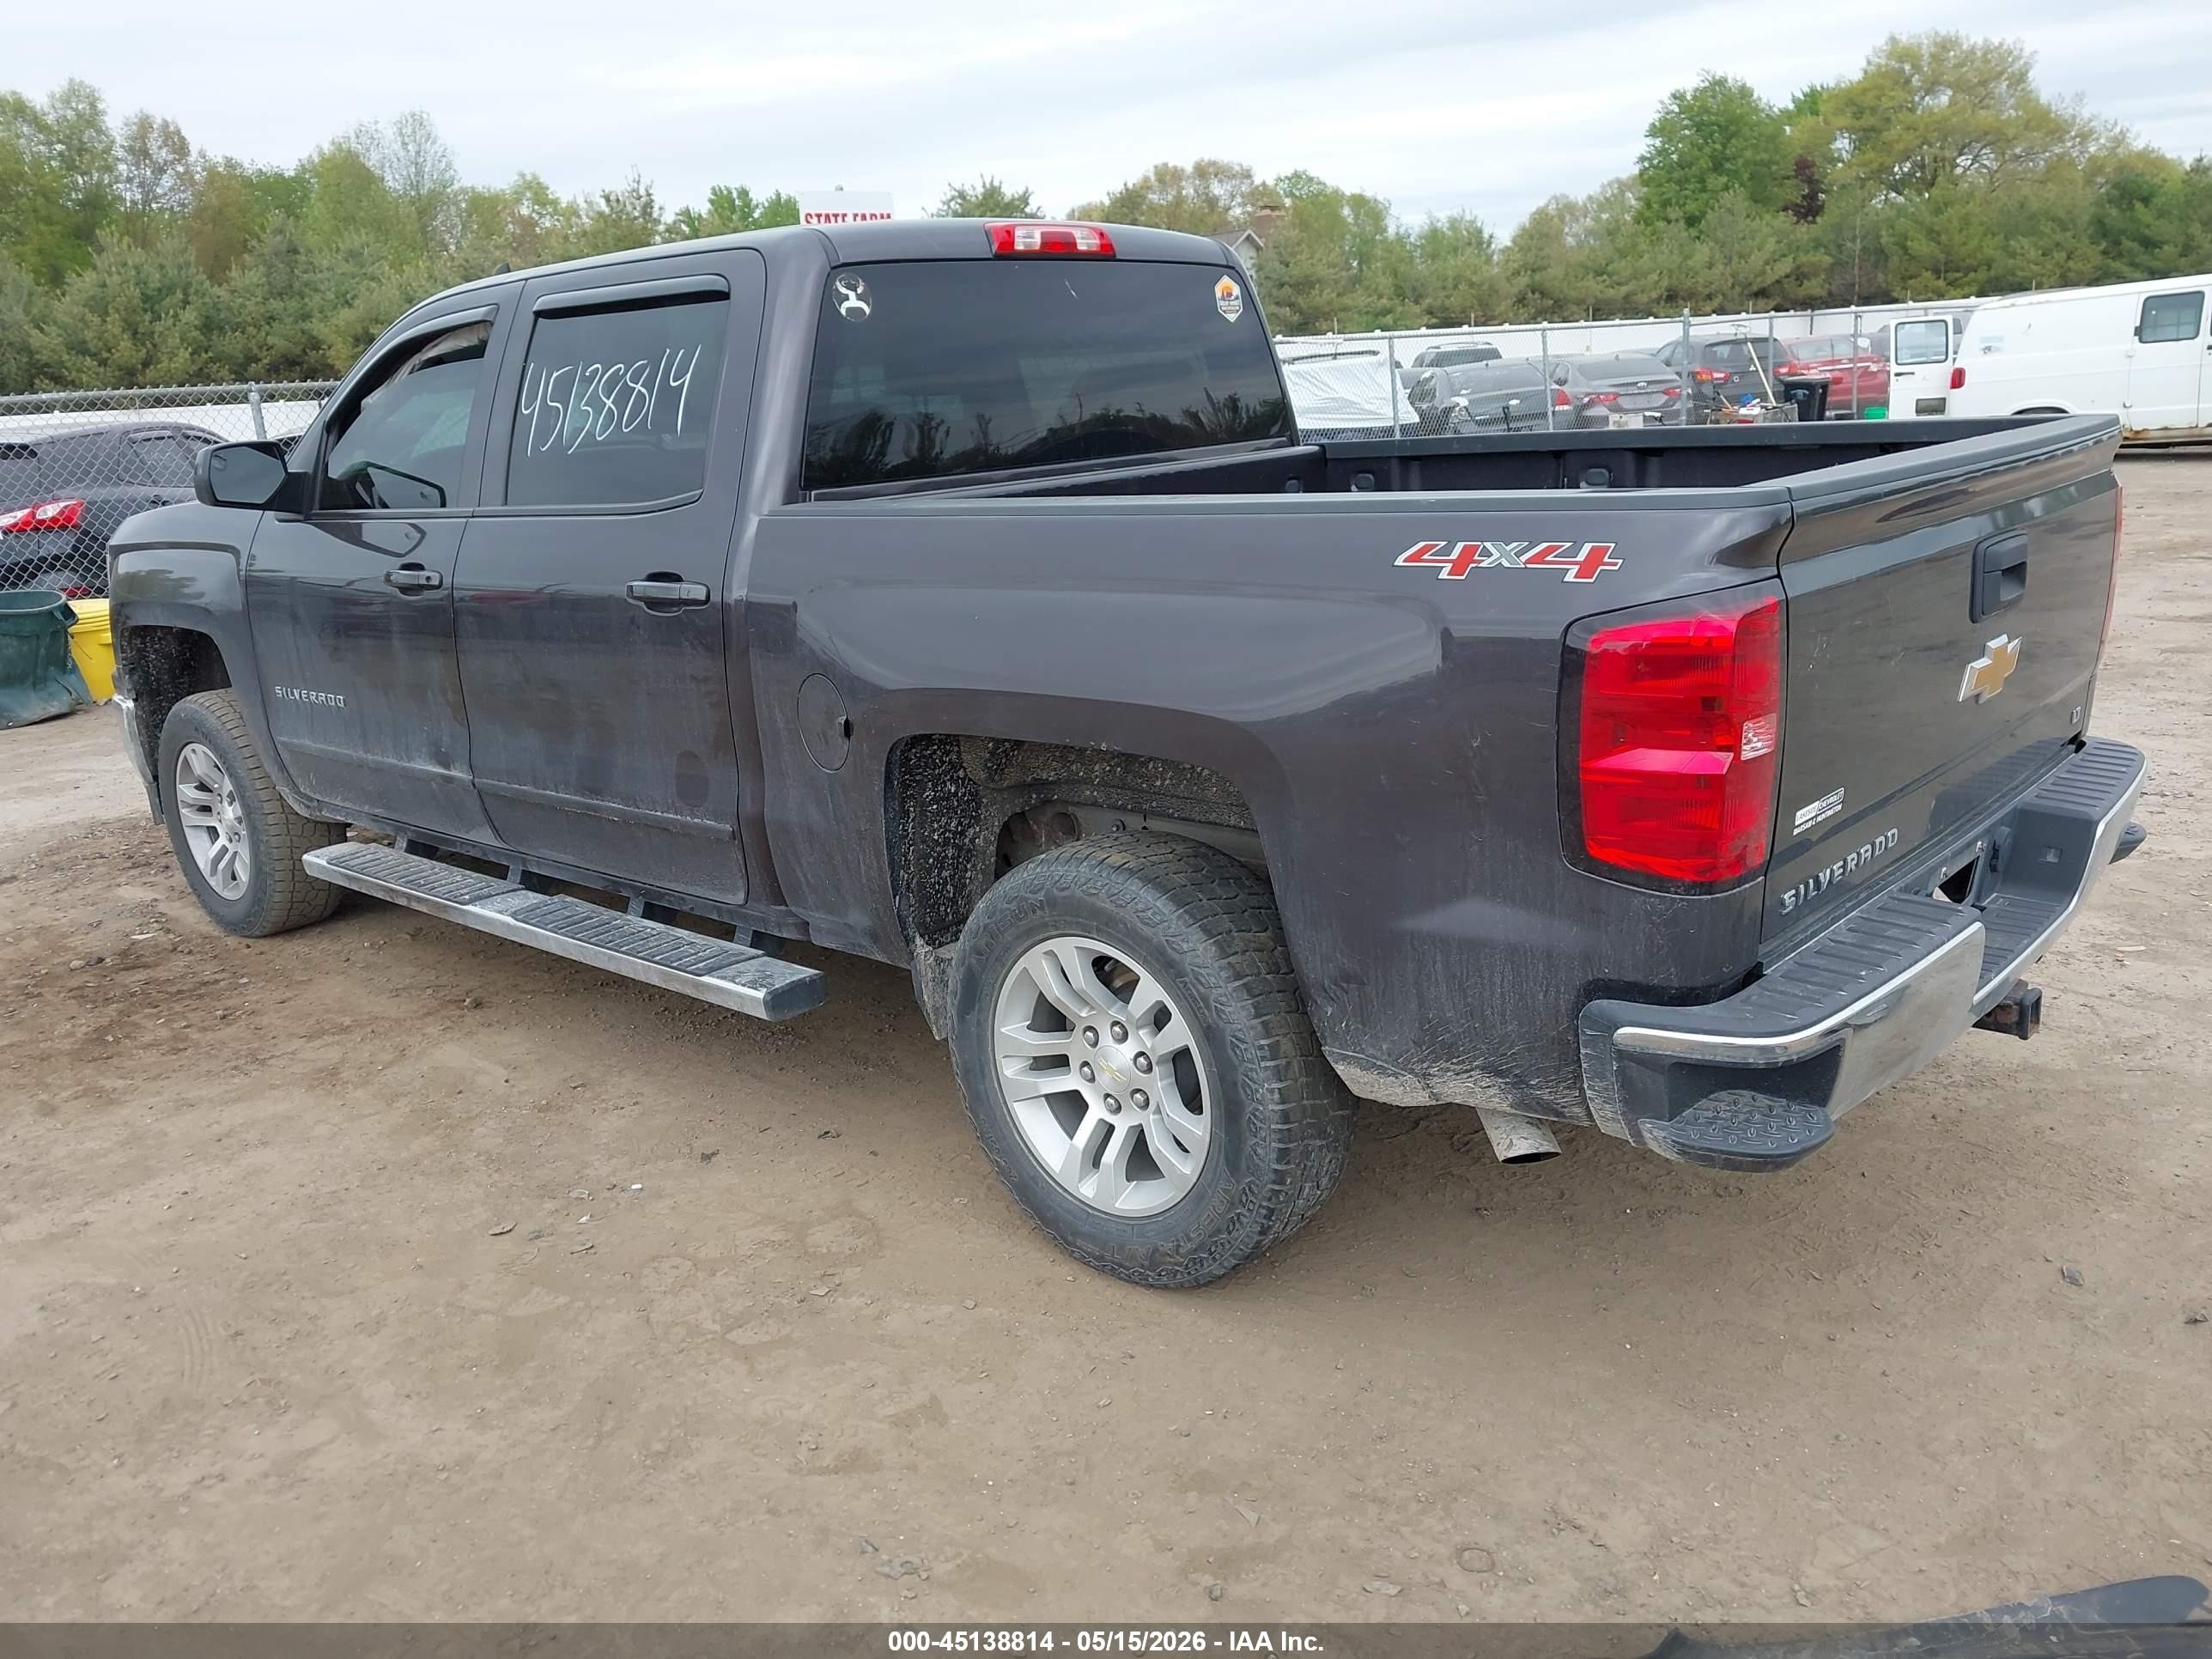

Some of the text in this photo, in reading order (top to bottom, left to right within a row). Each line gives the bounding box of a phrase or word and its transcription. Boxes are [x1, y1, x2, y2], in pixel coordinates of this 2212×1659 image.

[805, 212, 848, 224] STATE
[521, 343, 702, 457] 45138814
[274, 686, 345, 708] SILVERADO
[1779, 828, 1899, 915] SILVERADO
